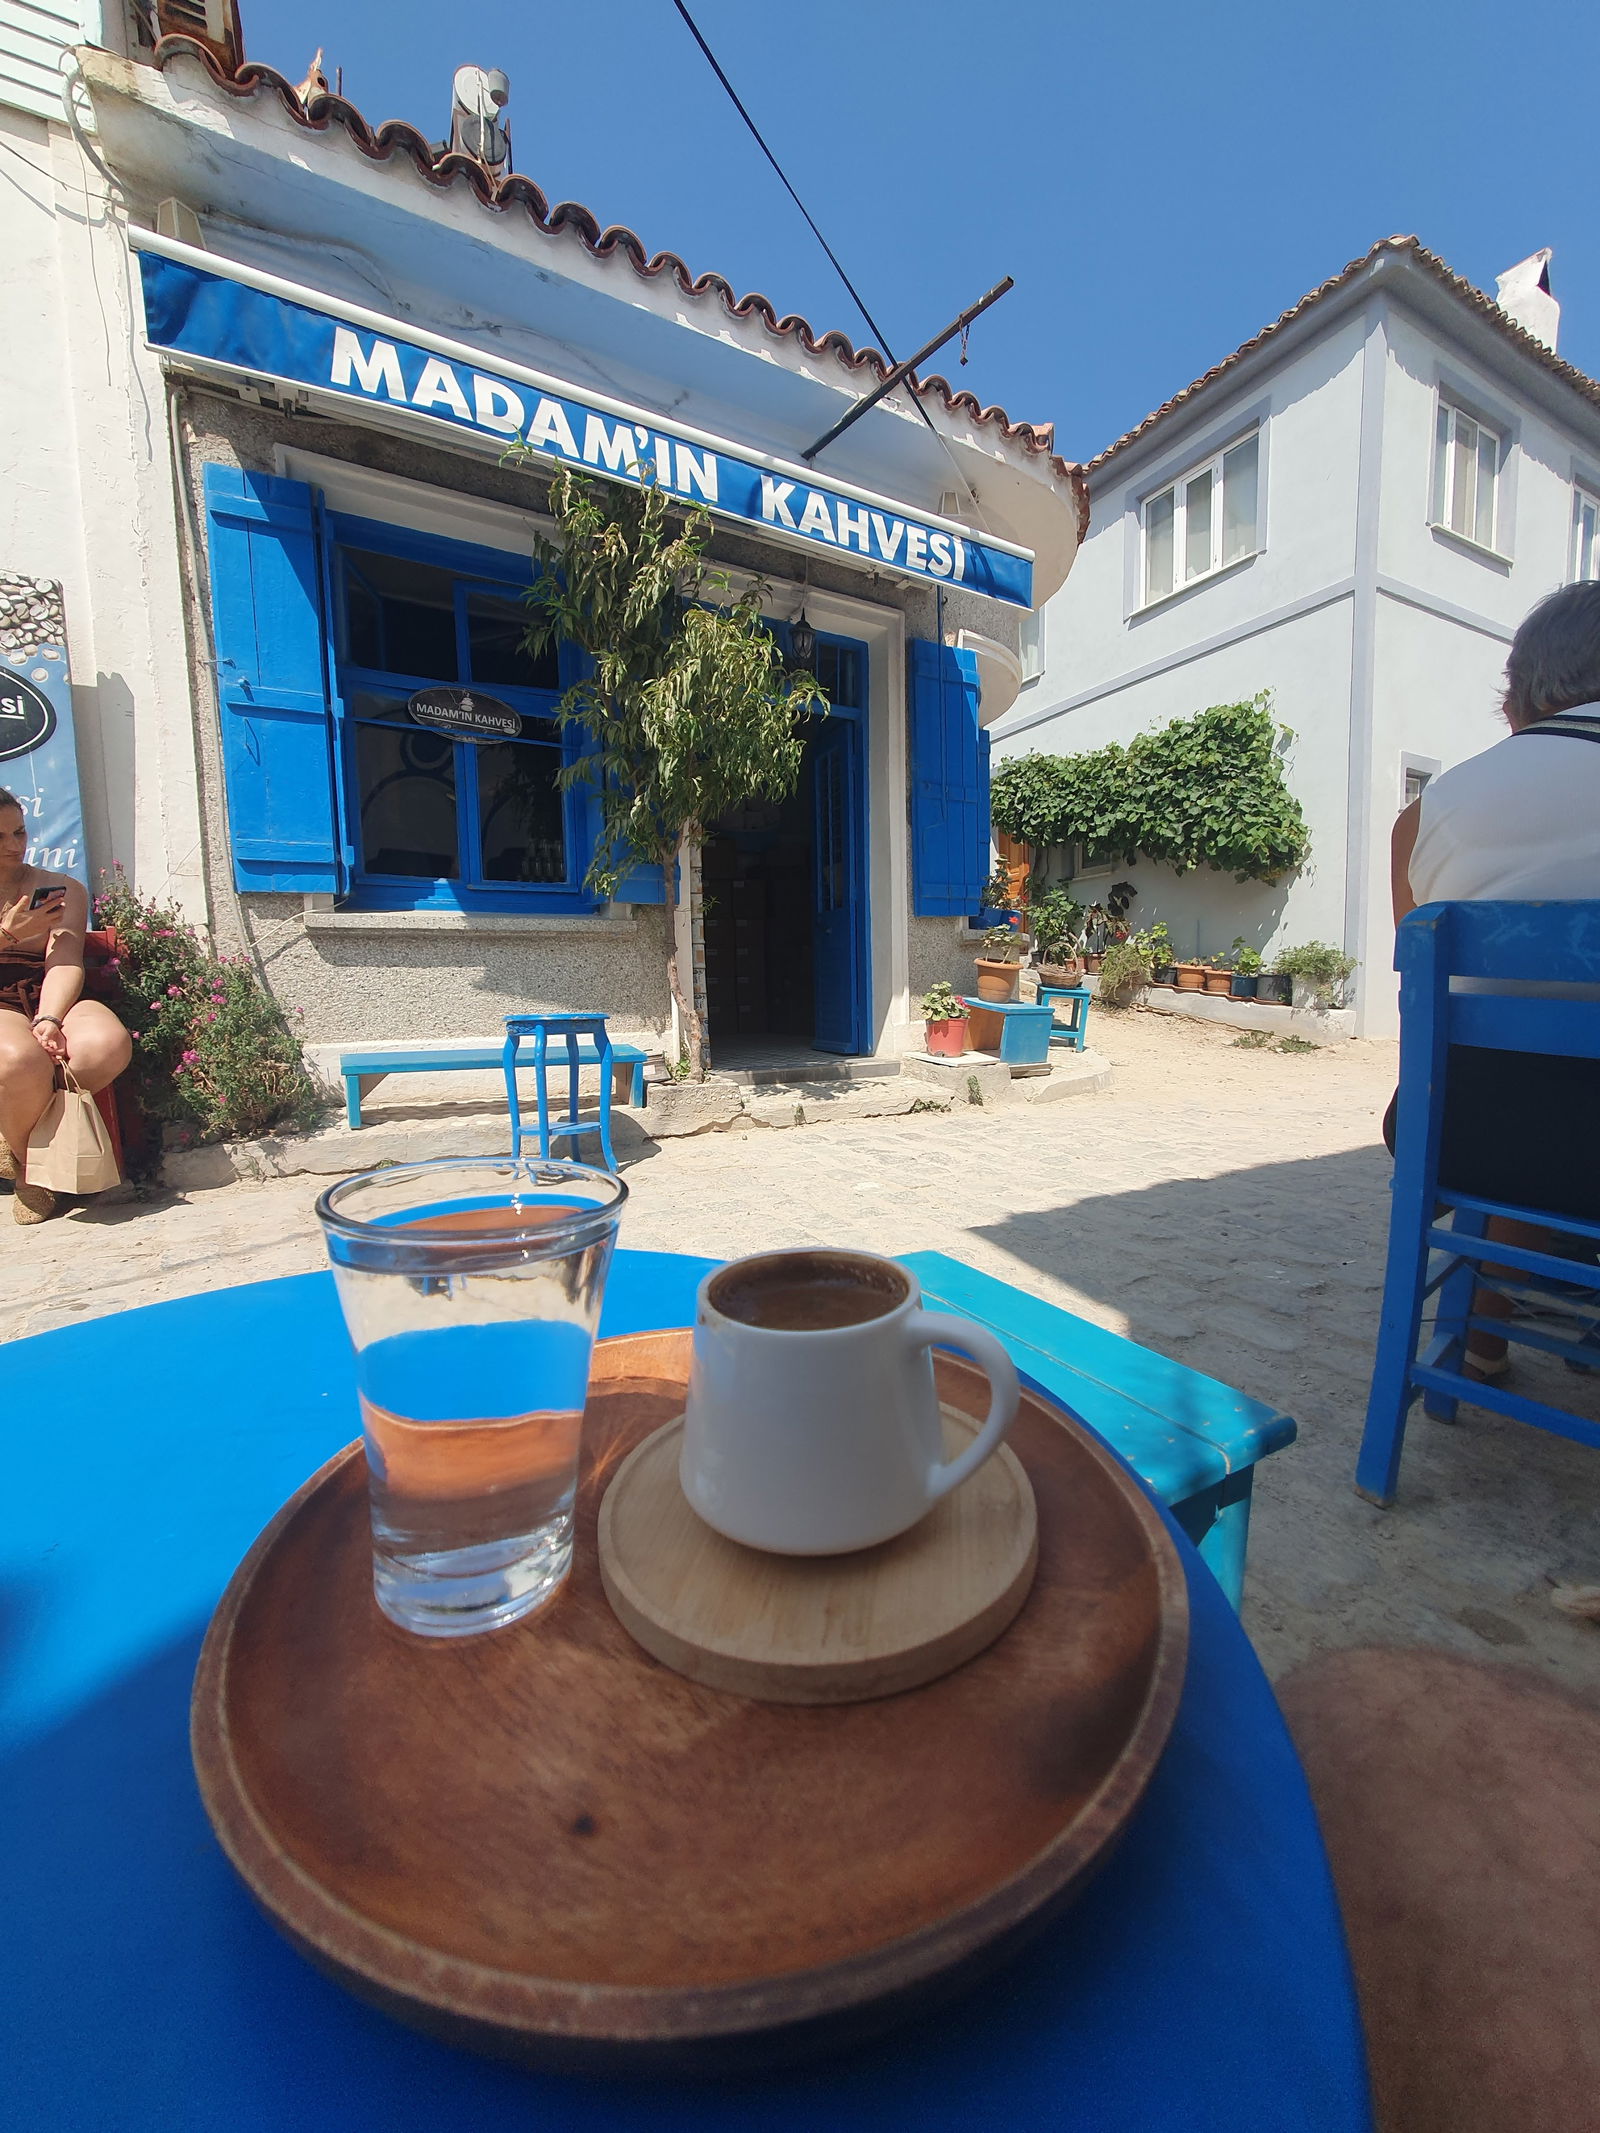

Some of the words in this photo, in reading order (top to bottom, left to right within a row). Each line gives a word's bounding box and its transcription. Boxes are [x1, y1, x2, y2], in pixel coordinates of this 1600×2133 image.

[330, 326, 719, 502] MADAM'IN
[760, 474, 966, 582] KAHVESİ
[416, 702, 473, 722] MADAM'IN
[474, 713, 516, 729] KAHVESİ
